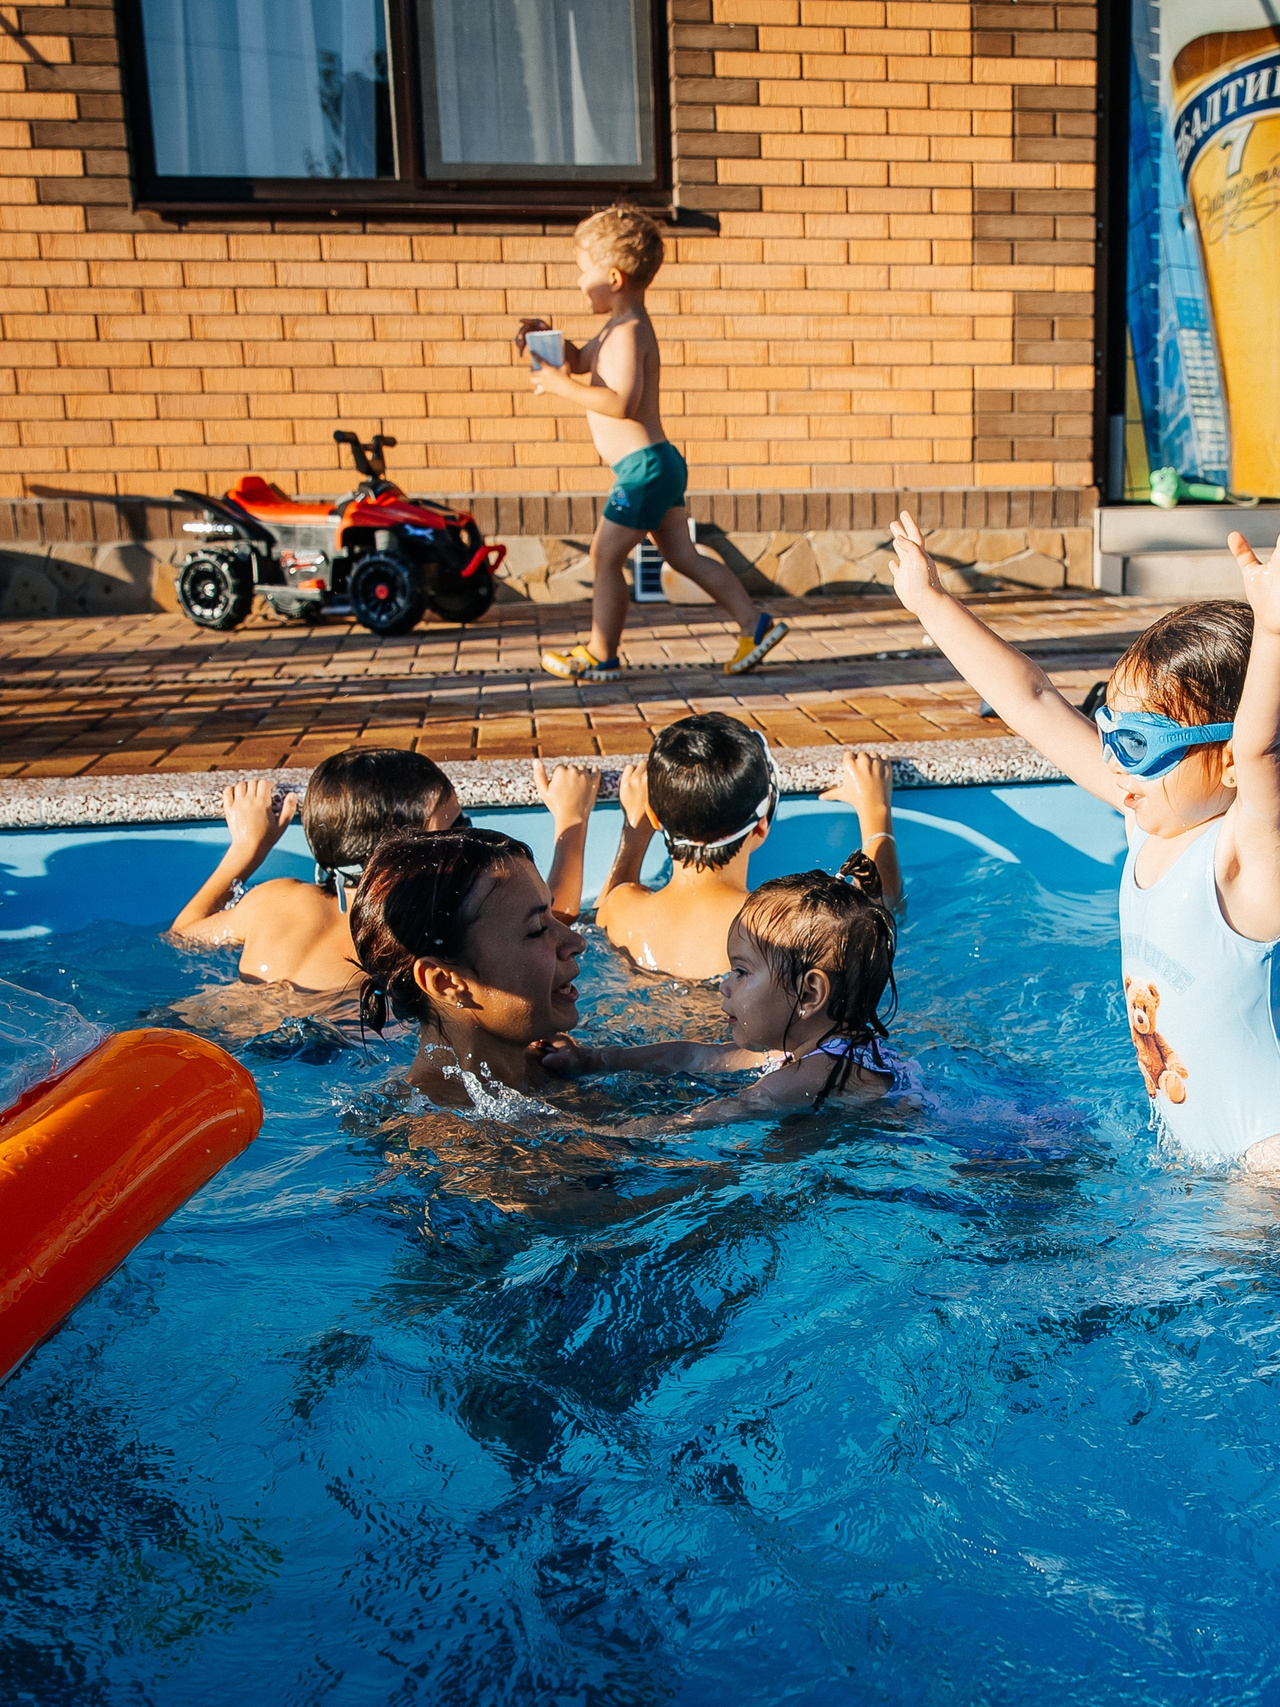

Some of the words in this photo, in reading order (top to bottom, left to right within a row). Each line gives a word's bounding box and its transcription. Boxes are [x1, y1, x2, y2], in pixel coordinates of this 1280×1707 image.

[1219, 121, 1256, 179] 7
[1158, 730, 1193, 744] arena
[1142, 936, 1197, 997] CUTE
